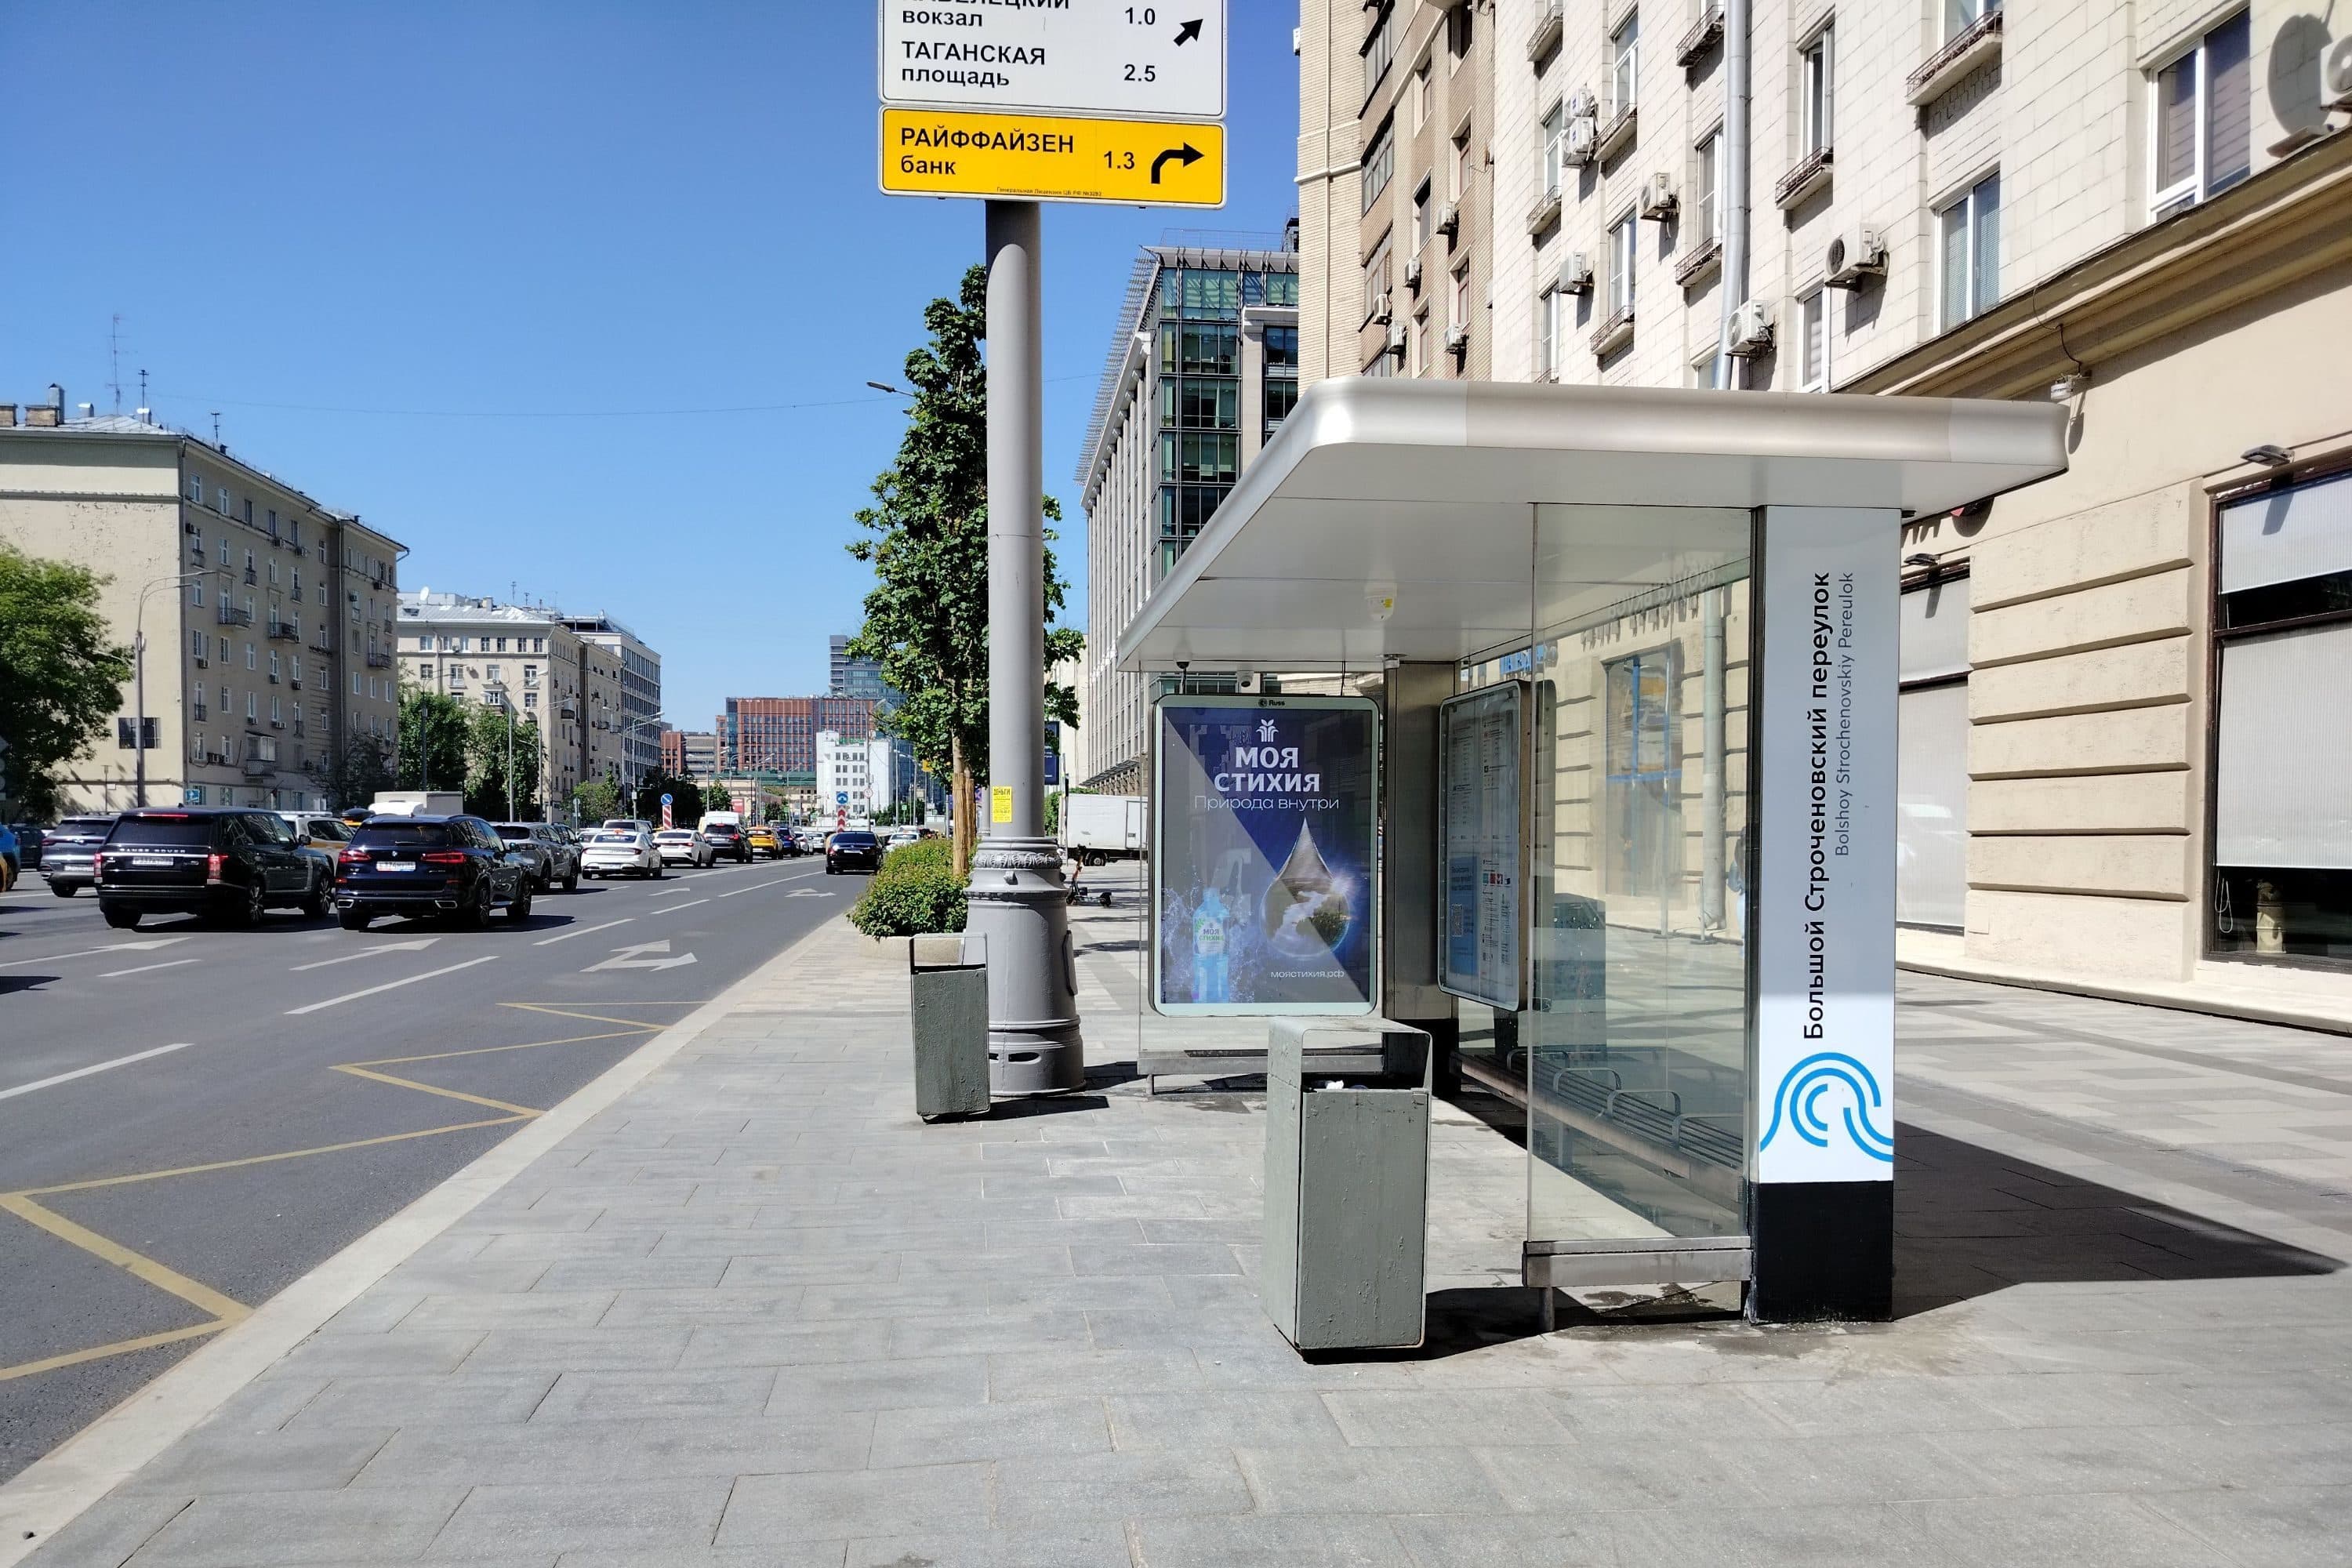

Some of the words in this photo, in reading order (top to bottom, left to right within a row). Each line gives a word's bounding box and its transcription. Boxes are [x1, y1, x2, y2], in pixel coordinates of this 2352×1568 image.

[902, 10, 982, 27] вокзал
[1125, 7, 1156, 25] 1.0
[902, 41, 1045, 65] ТАГАНСКАЯ
[902, 68, 1010, 89] площадь
[1123, 64, 1156, 82] 2.5
[901, 125, 1073, 153] РАЙФФАЙЗЕН
[901, 155, 956, 175] банк
[1104, 151, 1135, 169] 1.3
[1838, 572, 1853, 648] Pereulok
[1812, 572, 1834, 698] переулок
[1835, 654, 1855, 784] Strochenovskiy
[1235, 746, 1299, 768] МОЯ
[1214, 772, 1320, 793] СТИХИЯ
[1194, 795, 1274, 811] Природа
[1278, 798, 1339, 811] внутри
[1804, 709, 1829, 912] Строченовский
[1835, 789, 1853, 856] Bolshoy
[1270, 969, 1345, 978] моястихия.рф
[1803, 921, 1825, 1040] Большой
